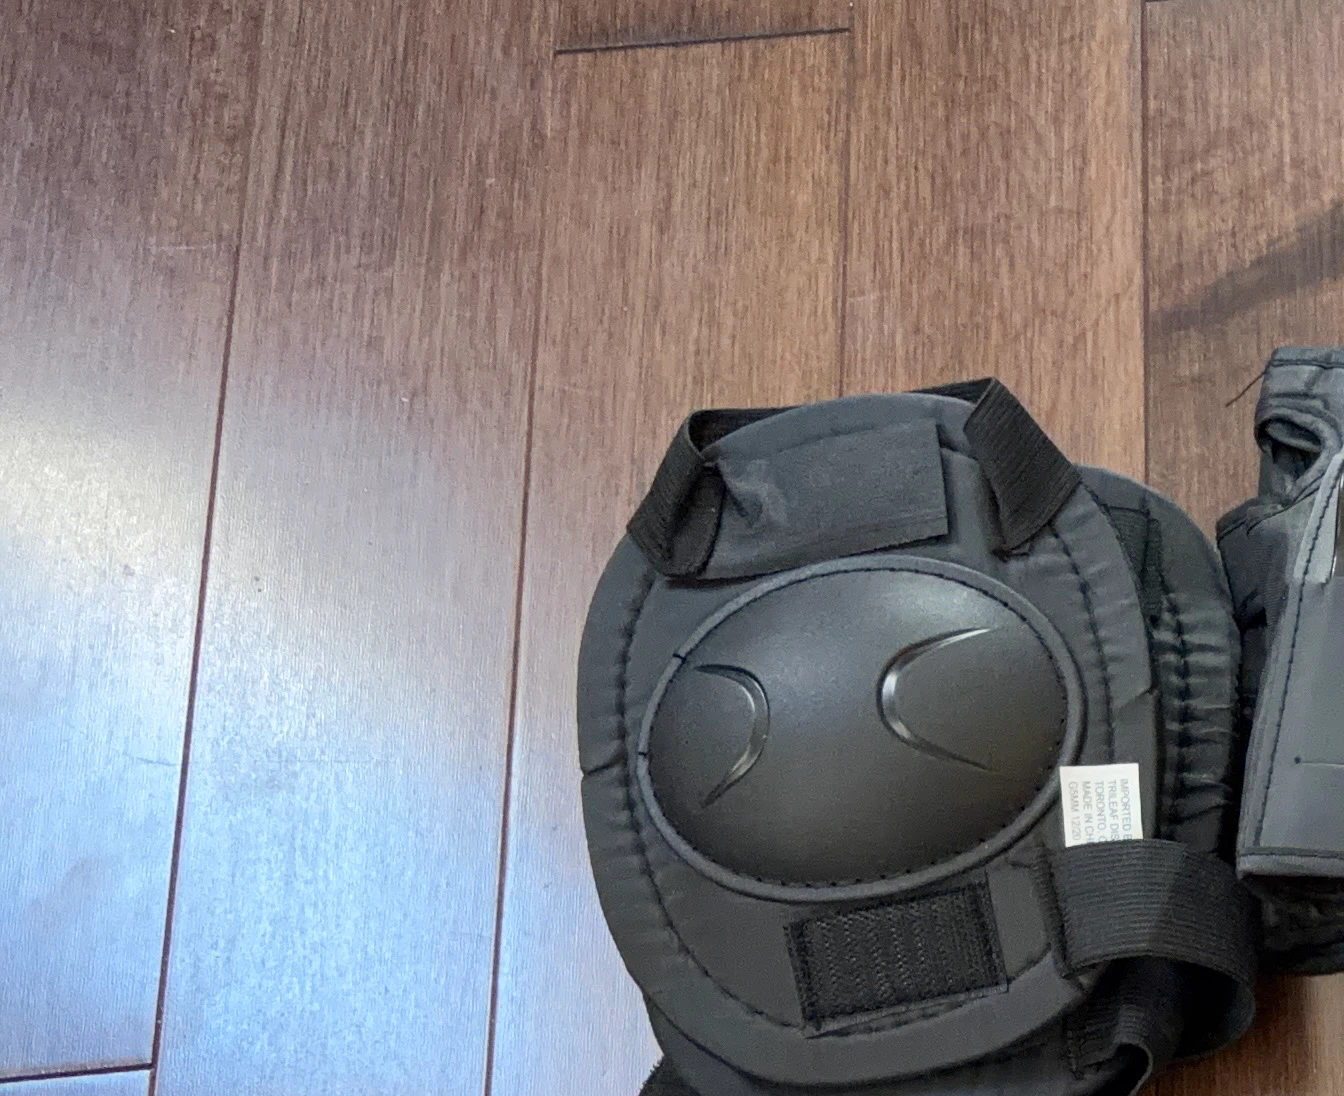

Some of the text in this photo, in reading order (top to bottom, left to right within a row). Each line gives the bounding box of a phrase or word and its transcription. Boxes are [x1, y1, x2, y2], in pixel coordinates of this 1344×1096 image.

[1082, 781, 1093, 810] MADE
[1107, 780, 1119, 820] TRILEAF
[1120, 778, 1132, 831] IMPORTED
[1084, 813, 1093, 824] IN
